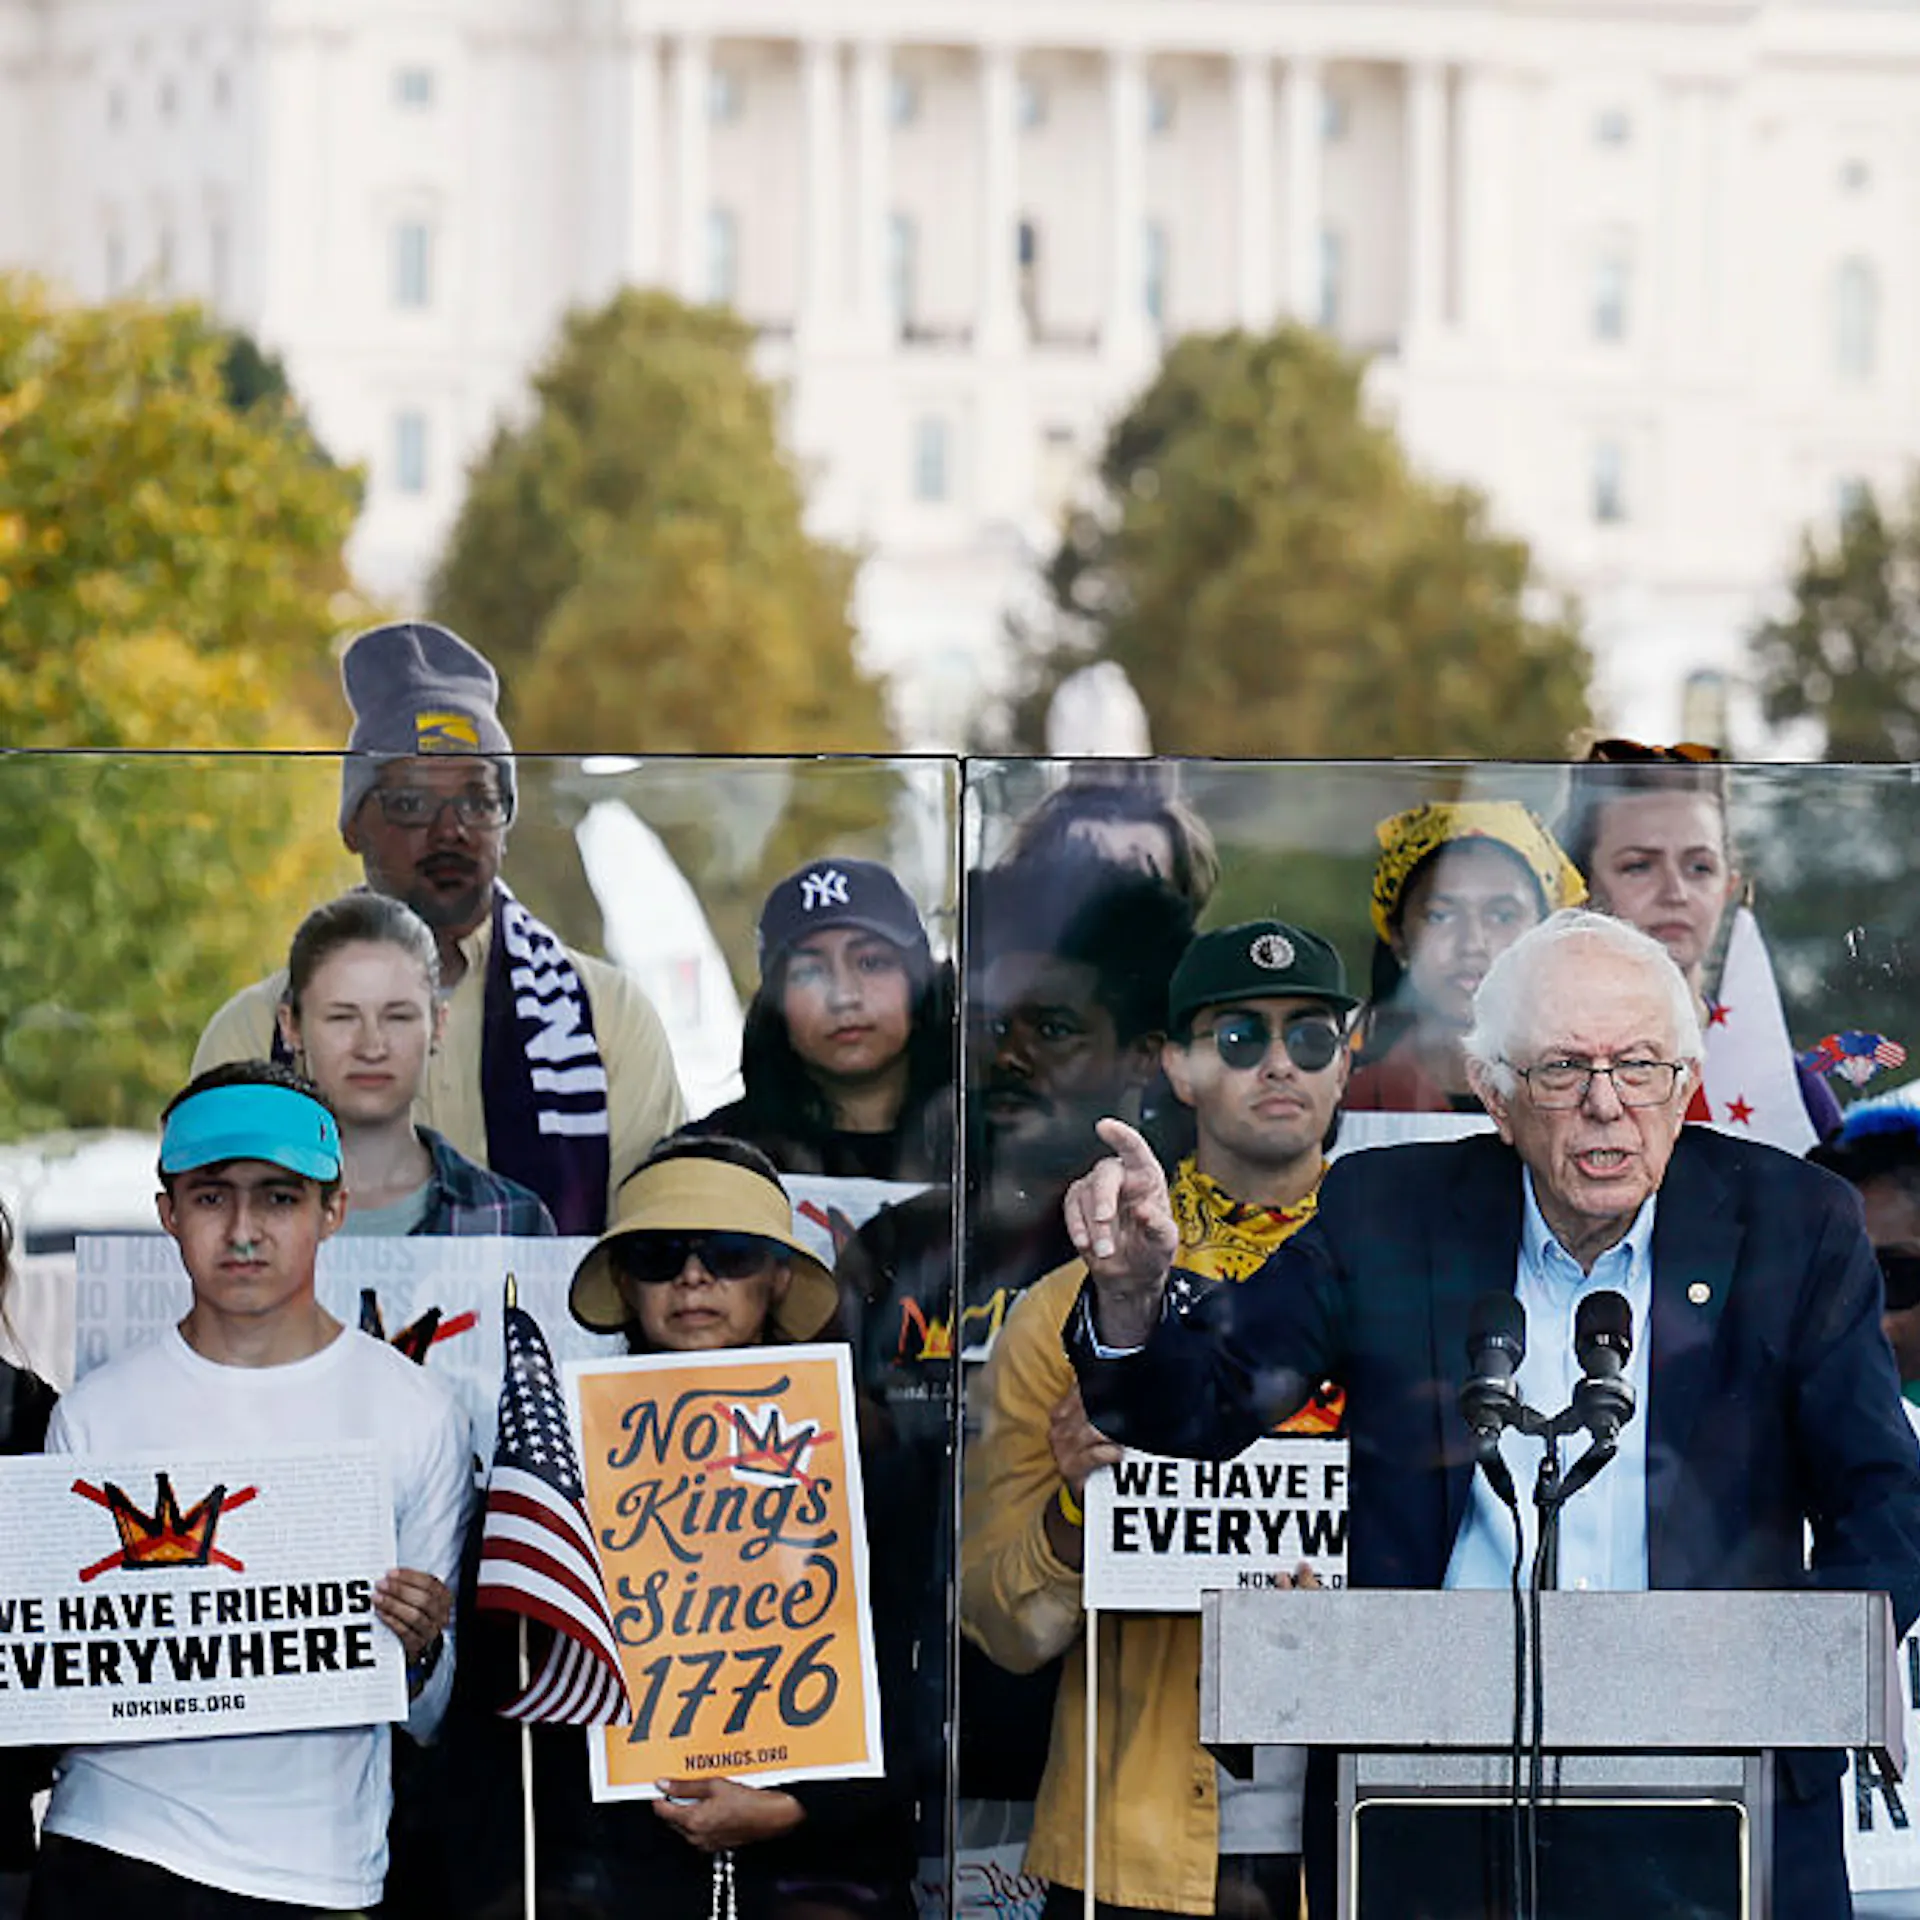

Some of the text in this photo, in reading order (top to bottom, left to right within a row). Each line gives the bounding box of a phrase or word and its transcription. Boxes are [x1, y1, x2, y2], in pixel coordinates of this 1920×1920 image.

[801, 868, 850, 911] NY
[608, 1375, 790, 1468] No
[1113, 1462, 1178, 1496] WE
[1195, 1460, 1308, 1498] HAVE
[602, 1473, 838, 1563] Kings
[59, 1592, 174, 1631] HAVE
[191, 1580, 371, 1625] FRIENDS
[613, 1553, 838, 1646] Since
[112, 1694, 245, 1719] NOKINGS.ORG
[627, 1633, 838, 1743] 1776
